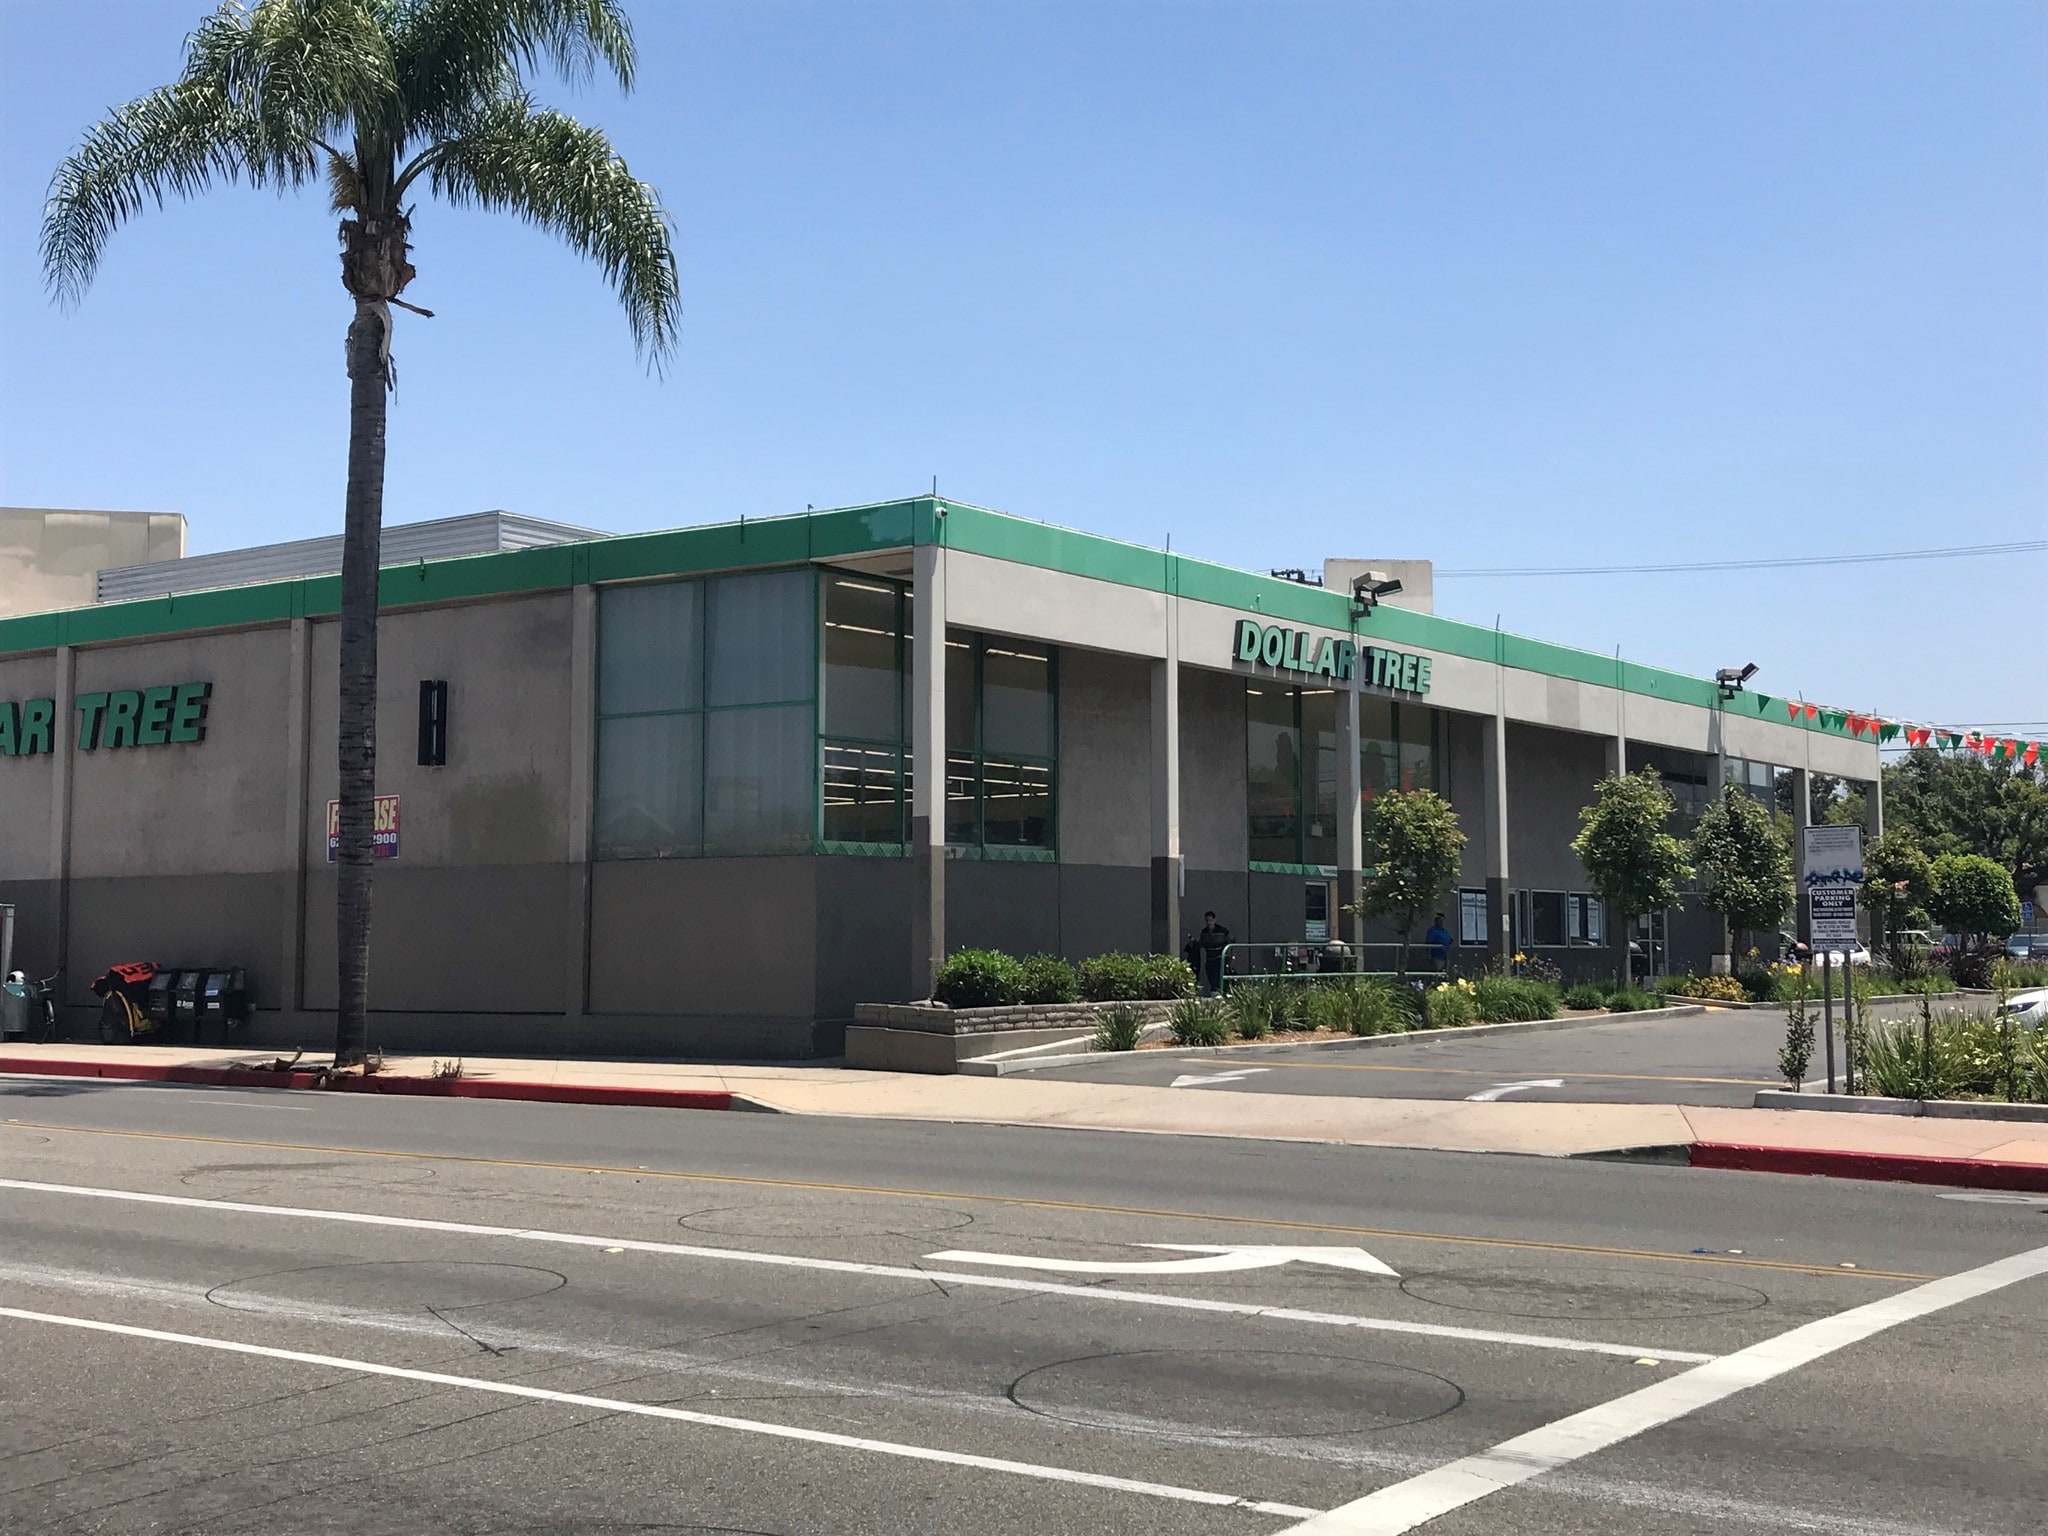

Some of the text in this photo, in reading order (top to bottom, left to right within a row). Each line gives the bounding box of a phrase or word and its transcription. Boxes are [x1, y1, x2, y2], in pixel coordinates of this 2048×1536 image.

[1236, 619, 1432, 695] DOLLAR TREE
[75, 682, 213, 751] TREE
